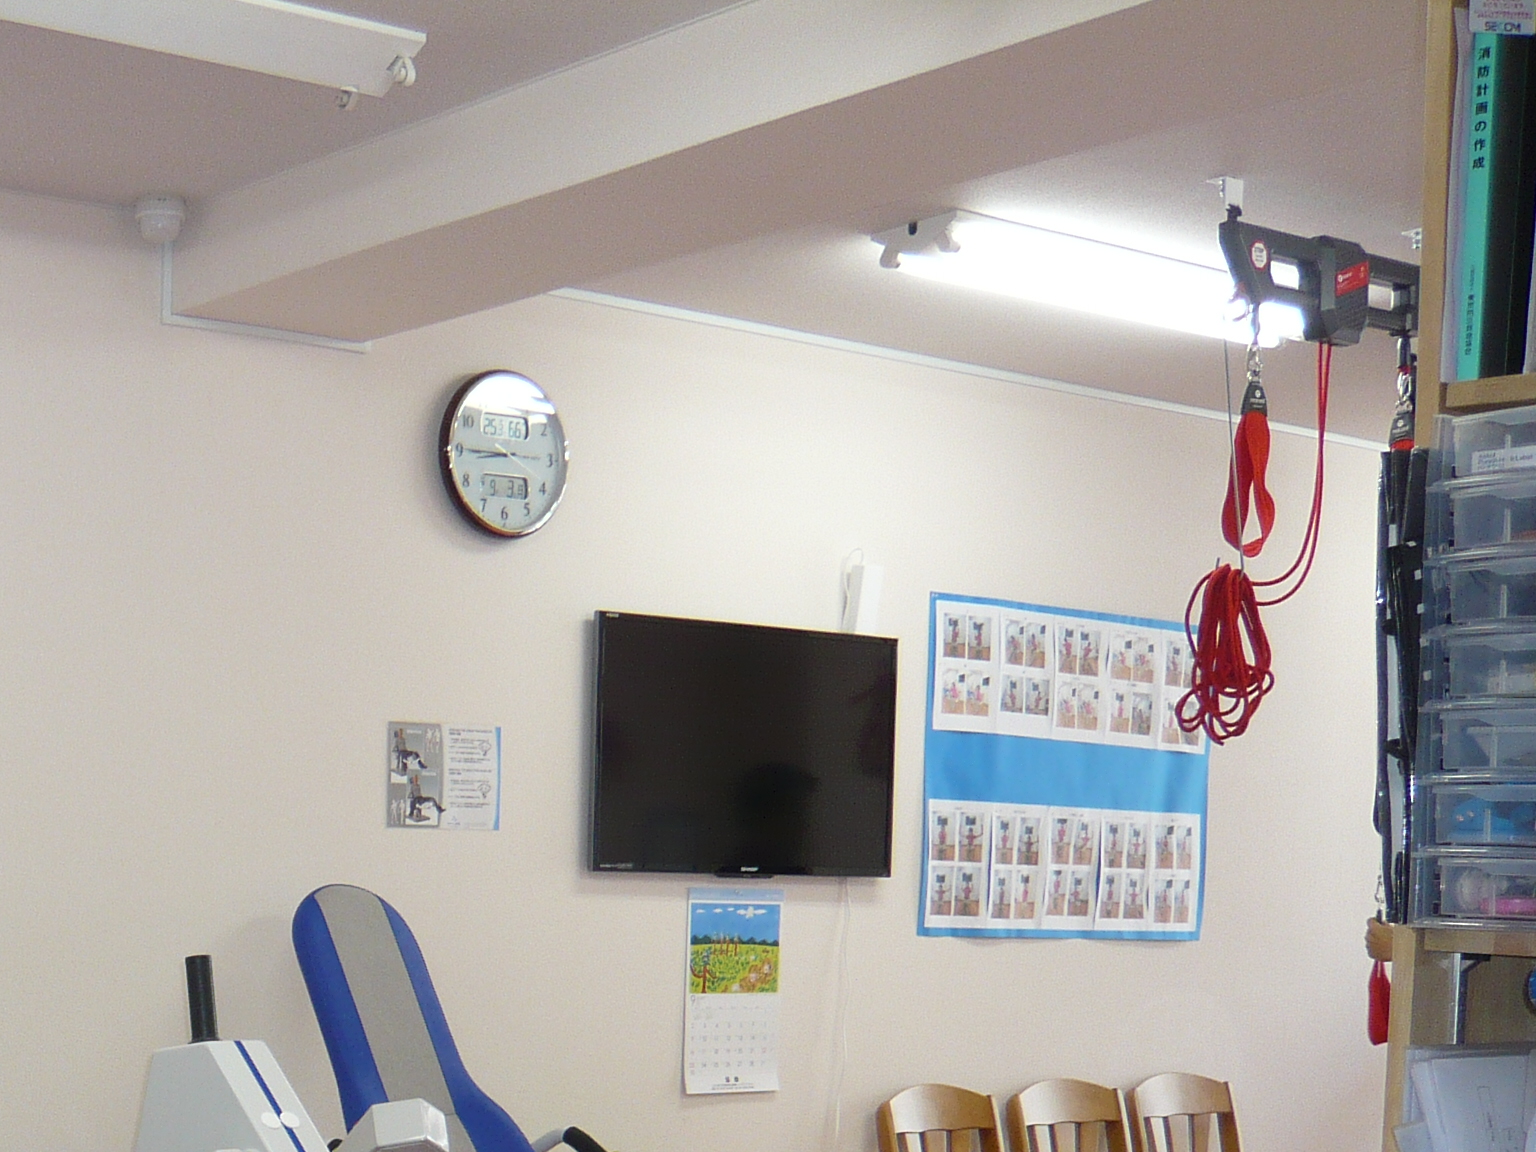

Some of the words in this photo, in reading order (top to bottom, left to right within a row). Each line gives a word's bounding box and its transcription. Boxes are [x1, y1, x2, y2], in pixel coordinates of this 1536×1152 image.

[1472, 45, 1492, 170] 消防計画の作成
[455, 443, 463, 457] 9
[546, 454, 554, 468] 3
[462, 474, 470, 487] 8
[539, 481, 547, 496] 4
[480, 498, 488, 512] 7
[524, 502, 531, 516] 5
[501, 506, 508, 520] 6
